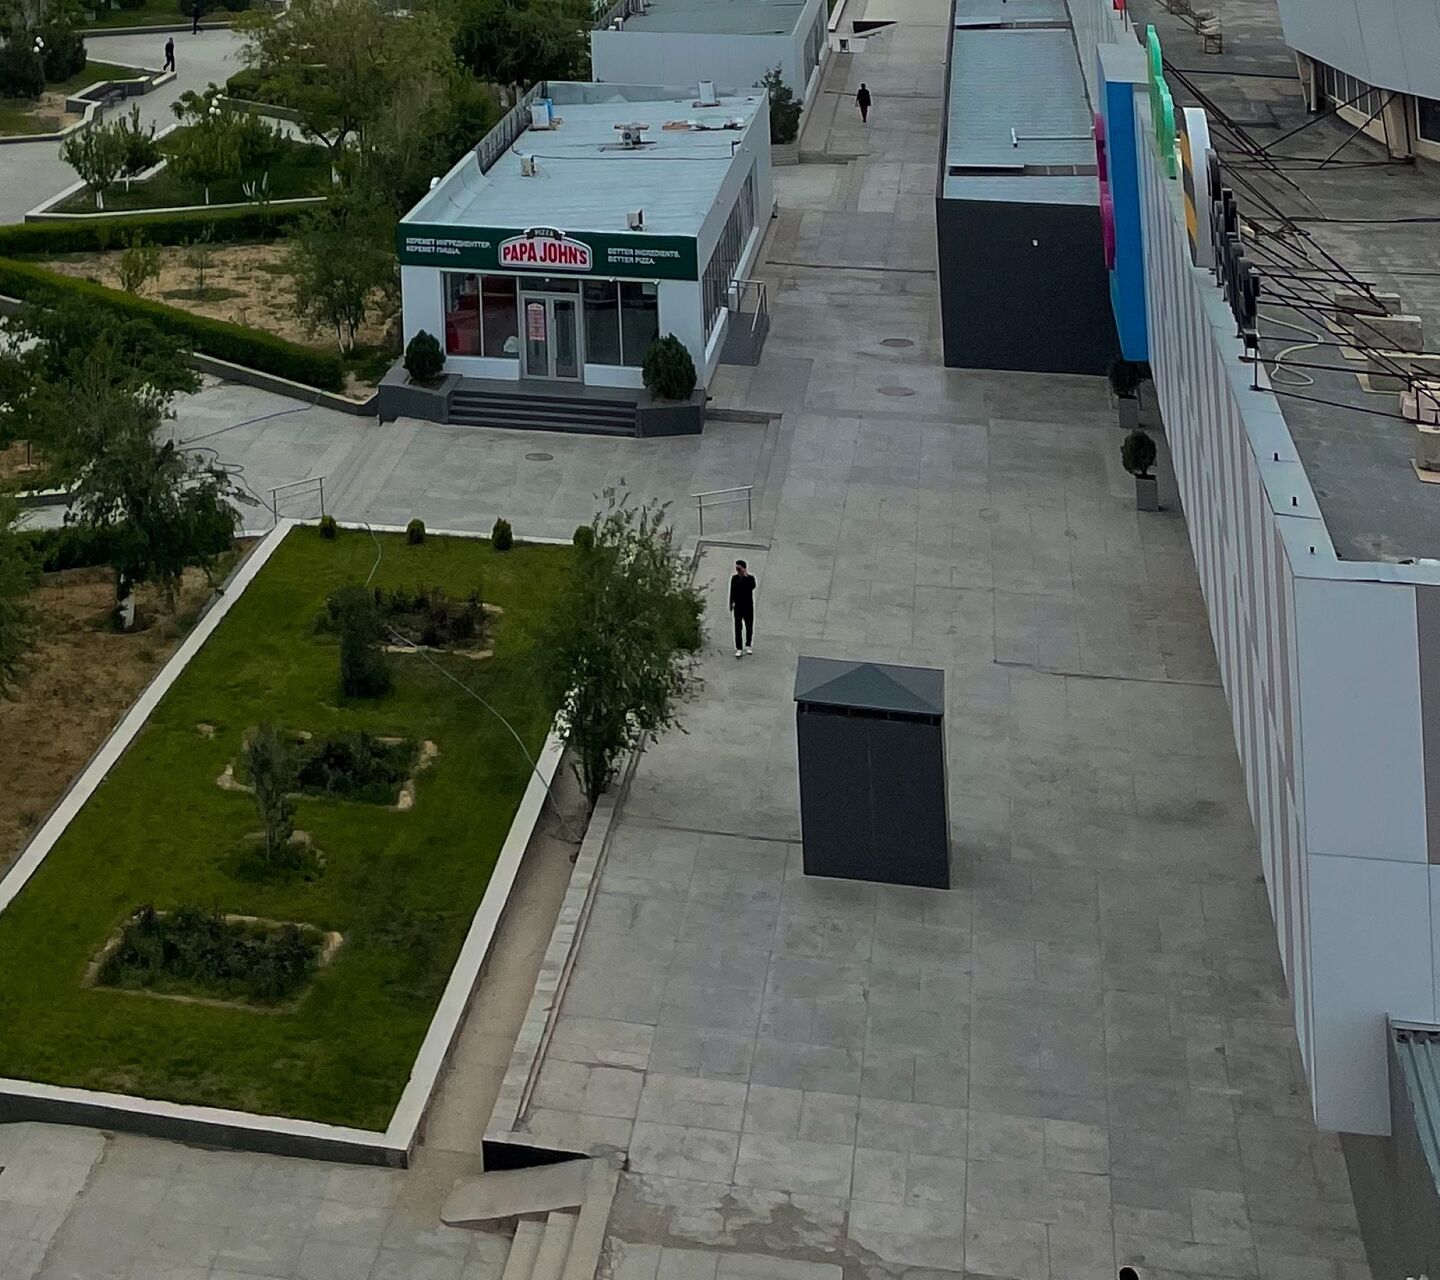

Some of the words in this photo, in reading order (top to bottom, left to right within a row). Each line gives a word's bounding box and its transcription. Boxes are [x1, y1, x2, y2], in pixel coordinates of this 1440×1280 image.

[534, 229, 554, 237] PIZZA
[503, 242, 538, 262] PAPA
[540, 242, 587, 265] JOHN'S
